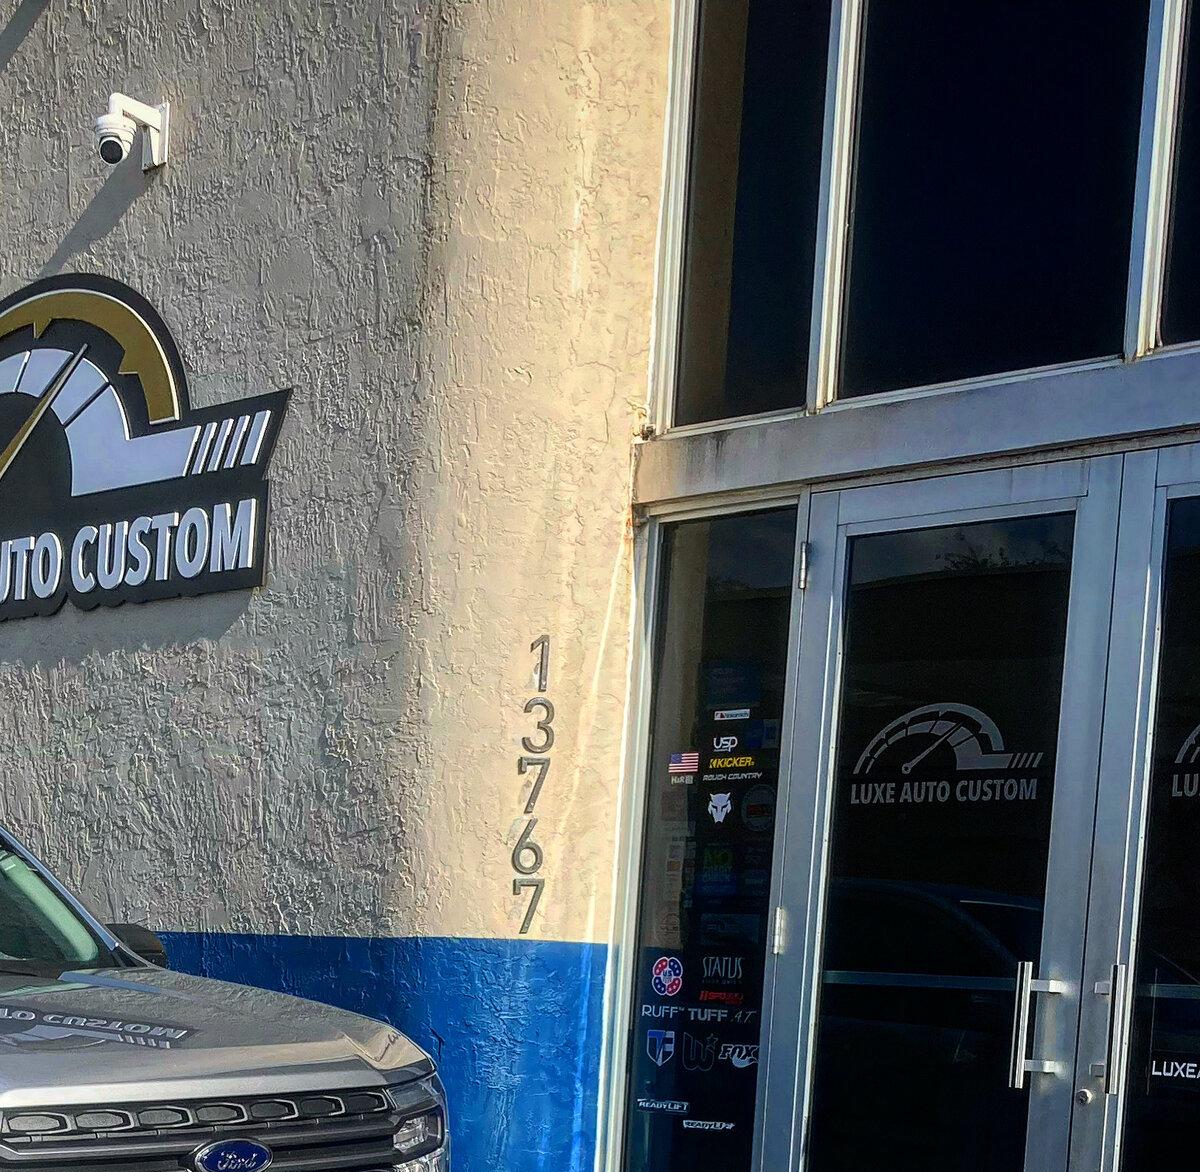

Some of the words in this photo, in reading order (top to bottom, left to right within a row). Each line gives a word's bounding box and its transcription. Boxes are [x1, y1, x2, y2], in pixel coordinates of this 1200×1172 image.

[70, 498, 257, 593] CUSTOM
[714, 756, 753, 768] KICKER
[511, 634, 555, 934] 13767
[728, 772, 762, 780] COUNTRY
[1172, 773, 1200, 797] LU
[851, 783, 896, 804] LUXE
[900, 781, 950, 803] AUTO
[956, 778, 1038, 801] CUSTOM
[702, 956, 744, 979] STATUS
[688, 1008, 728, 1022] TUFF
[218, 1150, 258, 1171] Ford
